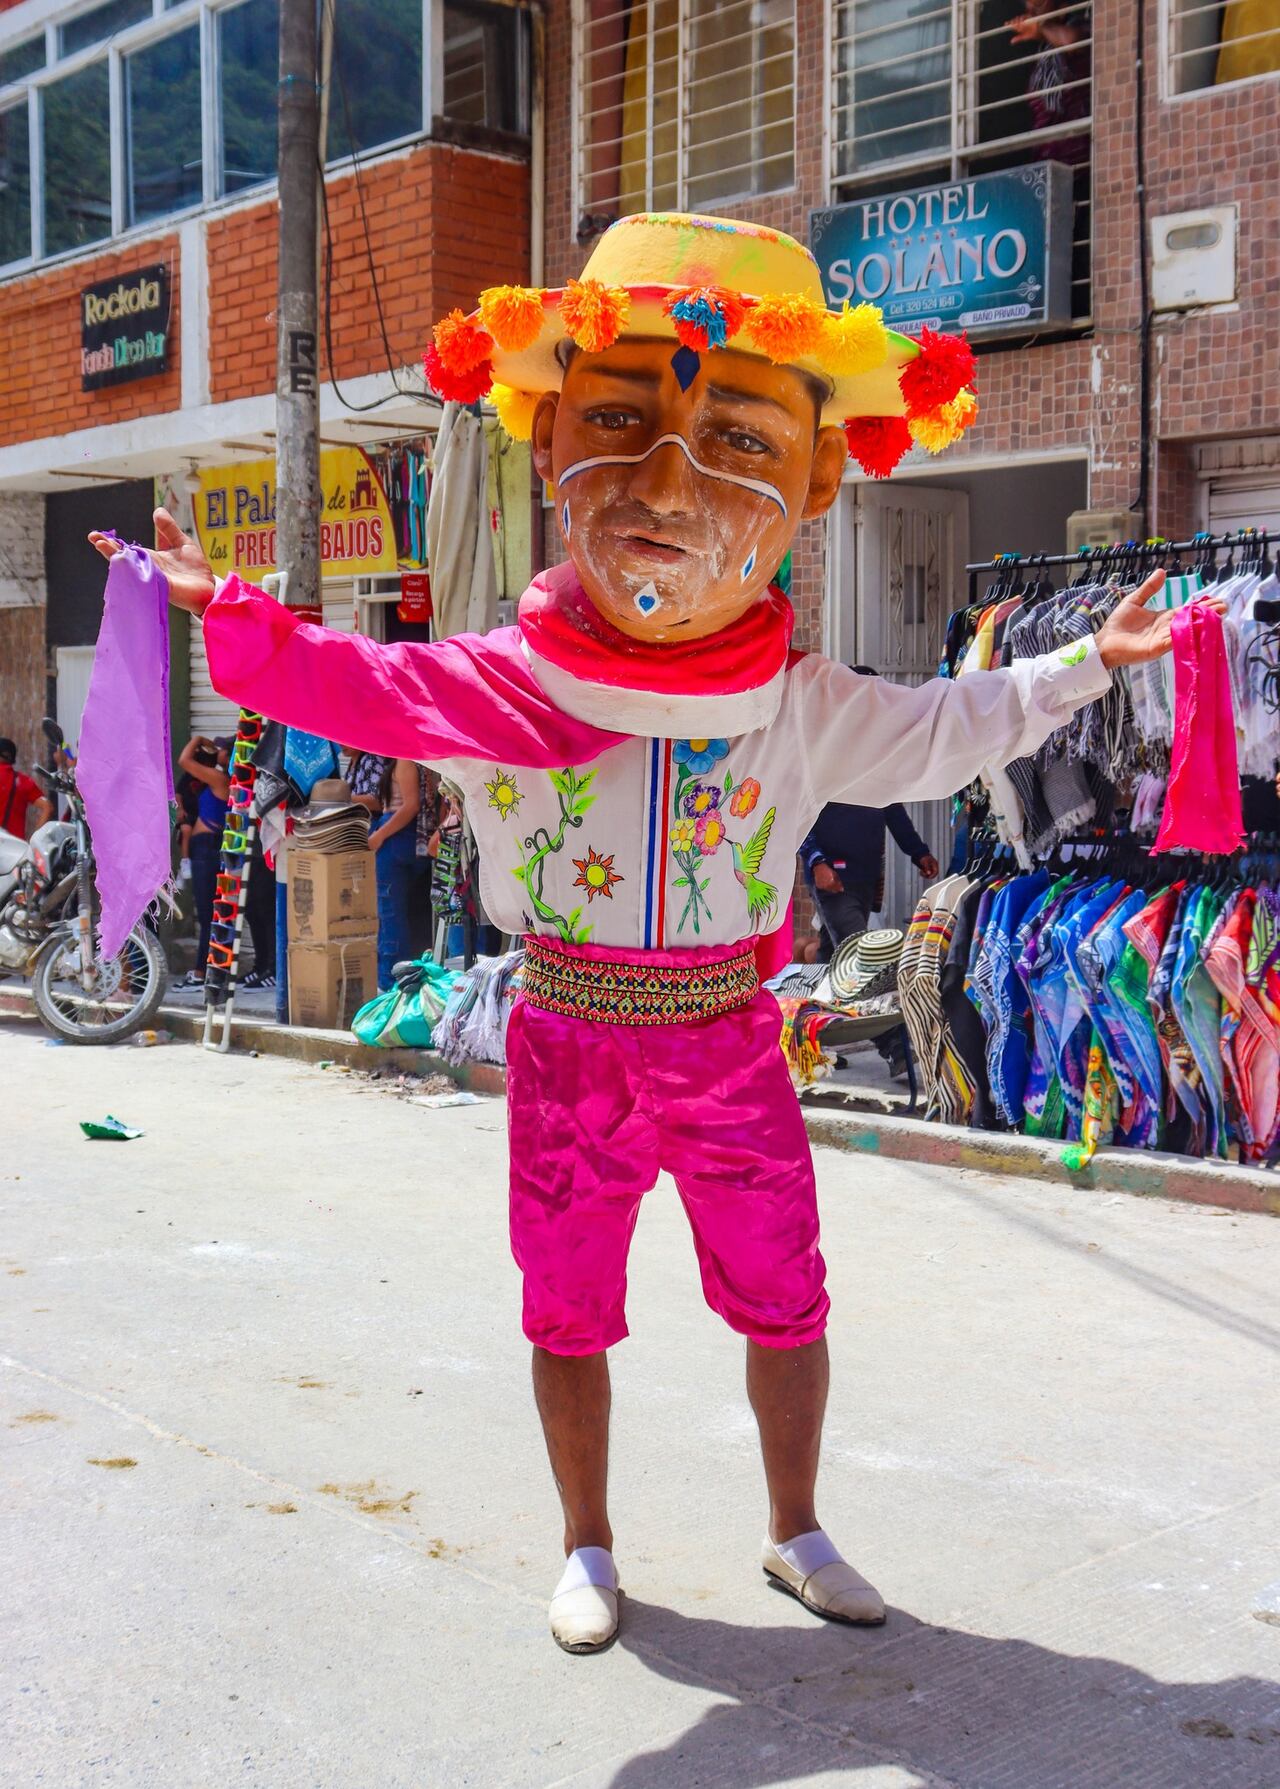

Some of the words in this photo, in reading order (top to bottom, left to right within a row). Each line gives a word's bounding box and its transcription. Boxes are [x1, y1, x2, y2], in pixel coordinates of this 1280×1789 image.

[861, 183, 990, 240] HOTEL
[827, 229, 1028, 306] SOLANO
[86, 278, 160, 325] Rockola
[906, 300, 921, 313] 320
[922, 297, 938, 310] 524
[994, 305, 1026, 320] PRIVADO
[206, 488, 228, 529] El
[327, 485, 346, 510] de
[233, 528, 277, 569] PREC
[320, 515, 384, 562] BAJOS
